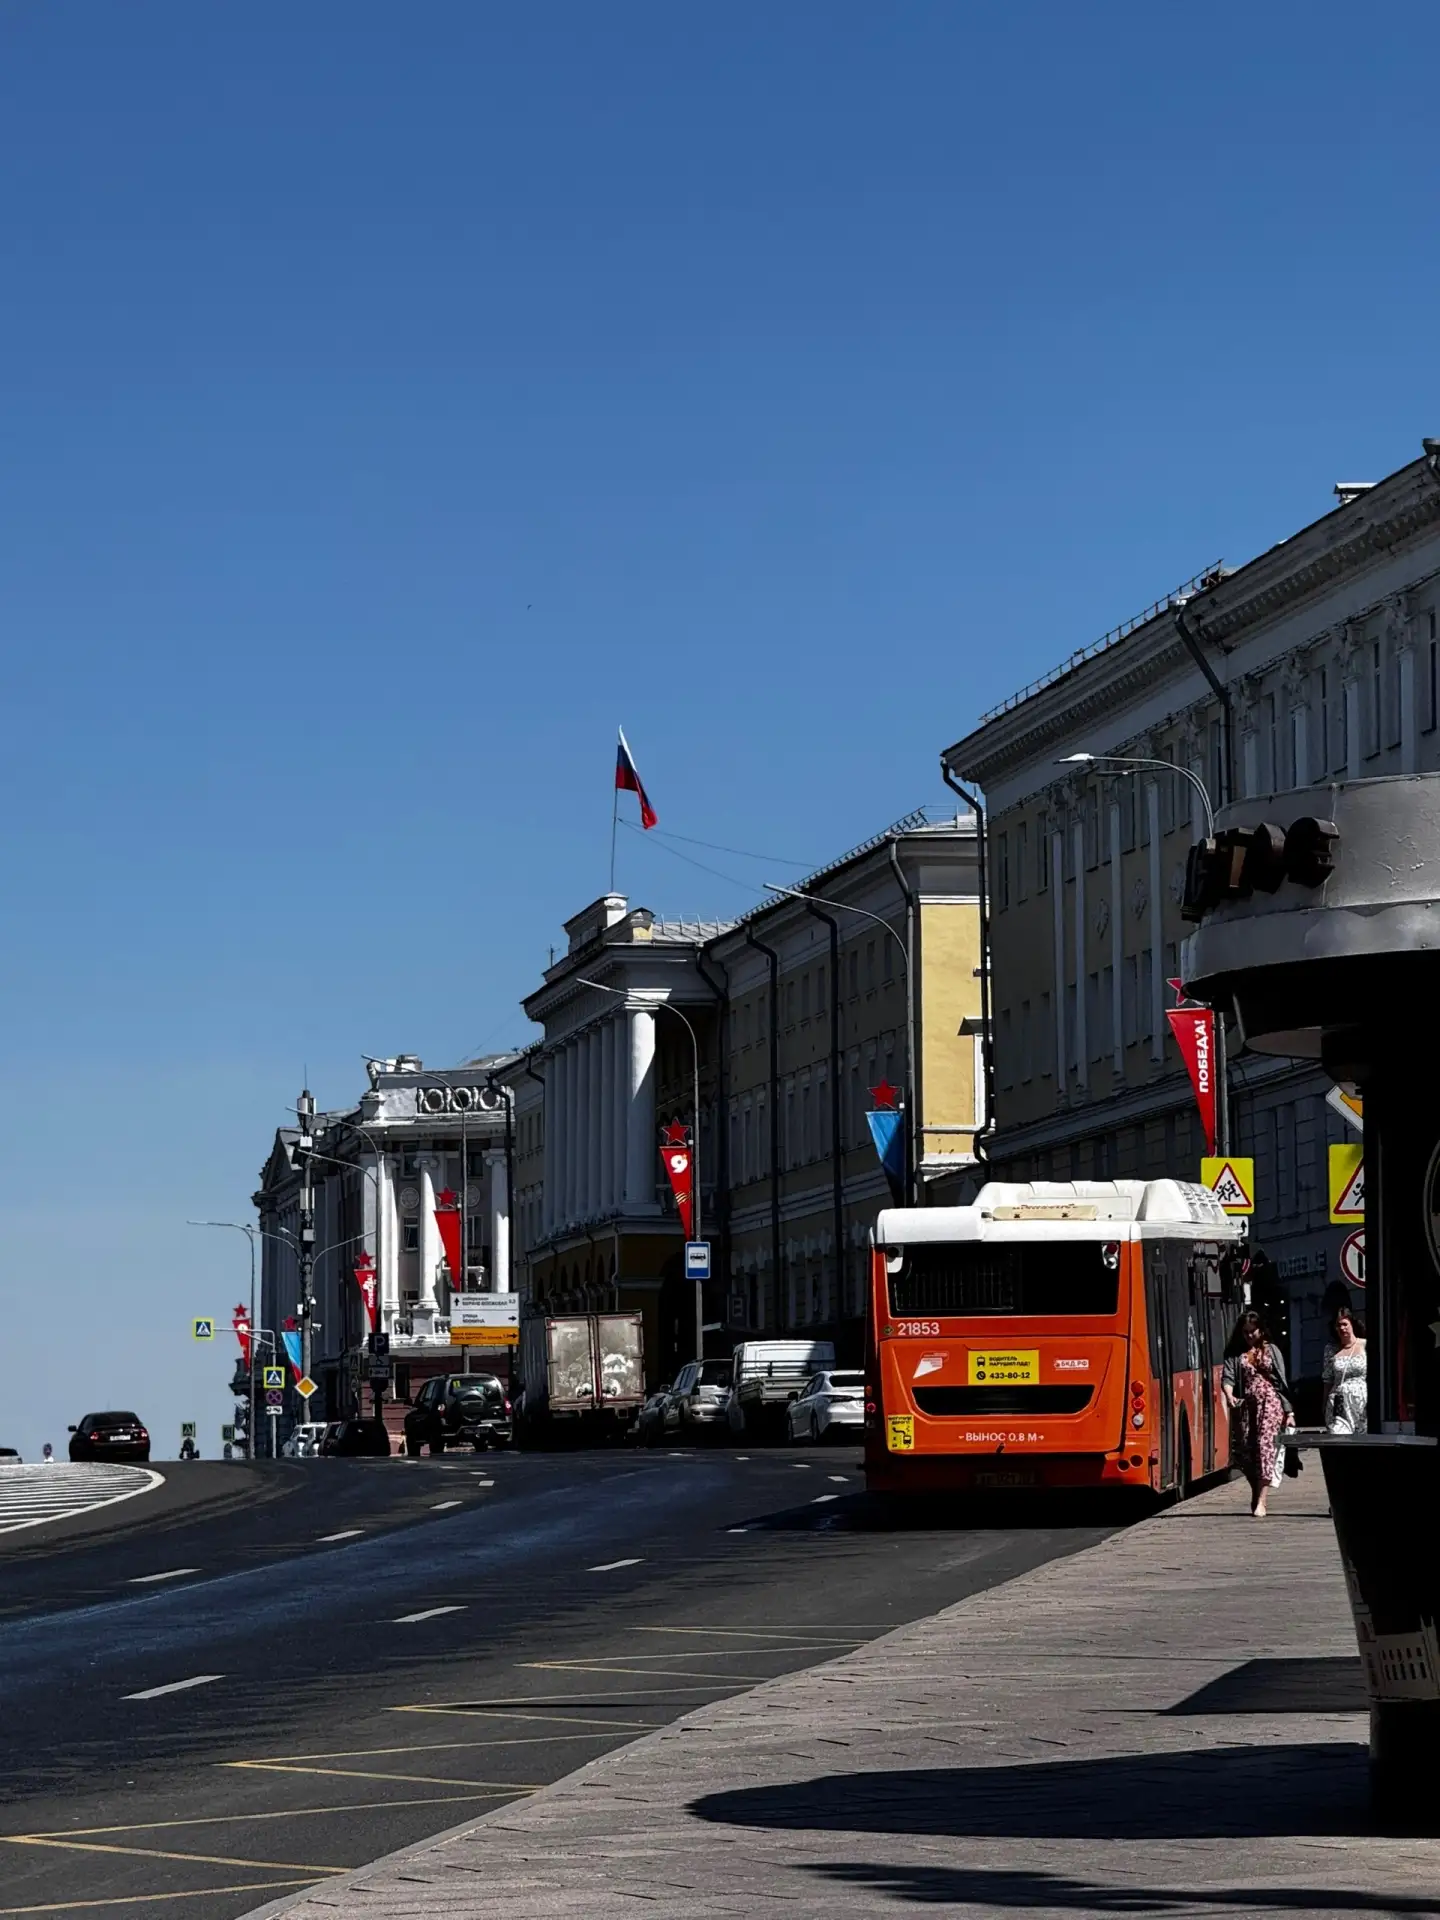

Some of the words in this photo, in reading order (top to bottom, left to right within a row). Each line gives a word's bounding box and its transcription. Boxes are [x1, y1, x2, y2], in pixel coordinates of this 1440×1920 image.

[1194, 1020, 1209, 1093] ПОБЕДА!
[671, 1154, 688, 1173] 9
[897, 1322, 940, 1336] 21853
[965, 1432, 1006, 1442] ВЫНОС
[1027, 1432, 1037, 1441] М
